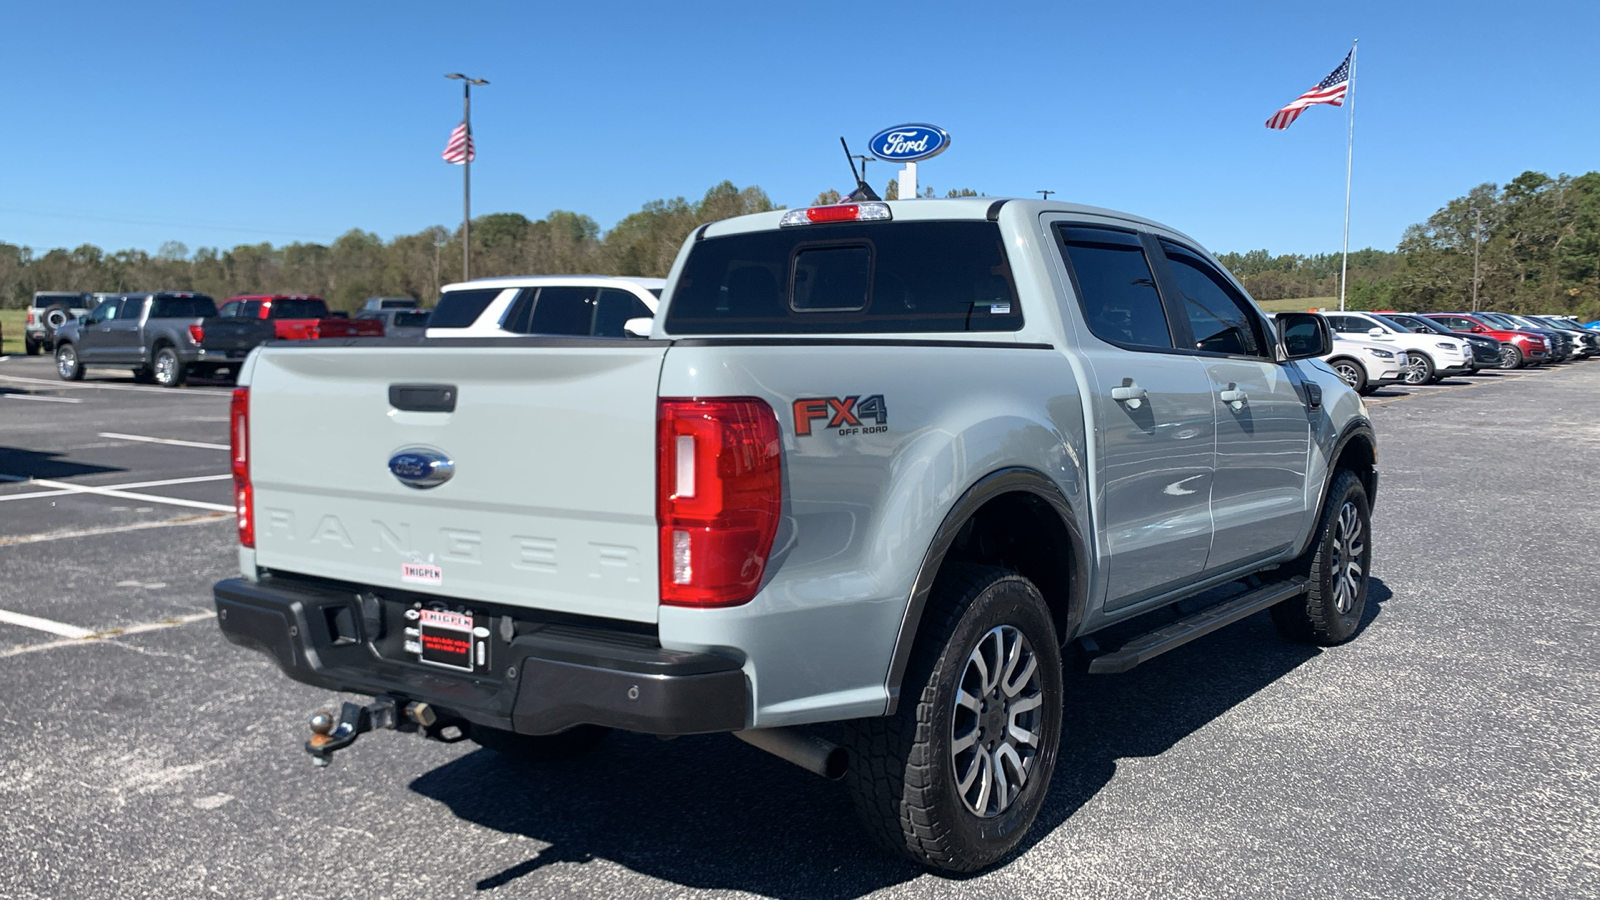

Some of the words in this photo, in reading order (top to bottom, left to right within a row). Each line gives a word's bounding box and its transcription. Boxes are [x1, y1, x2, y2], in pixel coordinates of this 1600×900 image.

[883, 131, 929, 155] Ford
[792, 394, 888, 437] FX4
[838, 428, 859, 436] OFF
[862, 425, 888, 435] ROAD
[264, 506, 639, 583] RANGER
[404, 566, 440, 578] THIGPEN
[423, 611, 471, 626] THIGPEN
